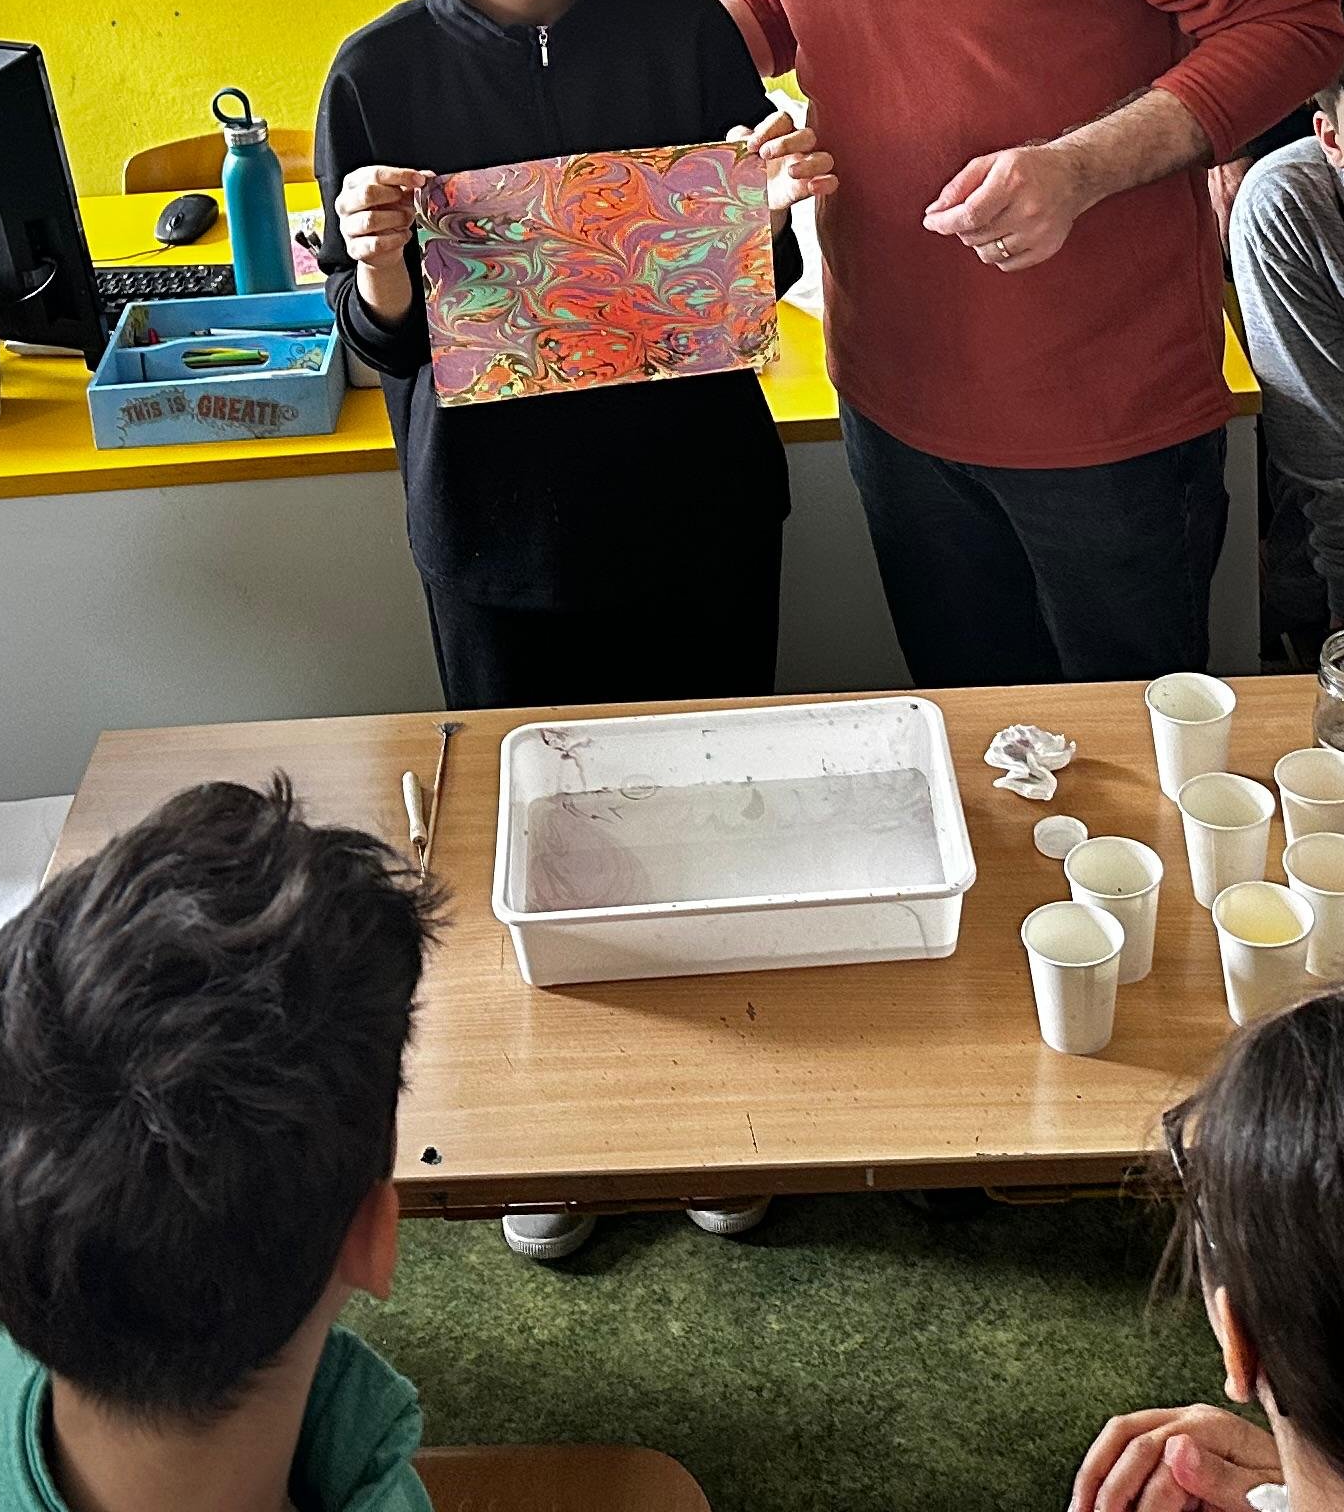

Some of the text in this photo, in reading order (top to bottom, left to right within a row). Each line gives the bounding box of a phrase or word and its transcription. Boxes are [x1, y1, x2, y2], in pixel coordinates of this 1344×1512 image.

[122, 394, 281, 426] THIS IS GREAT!
